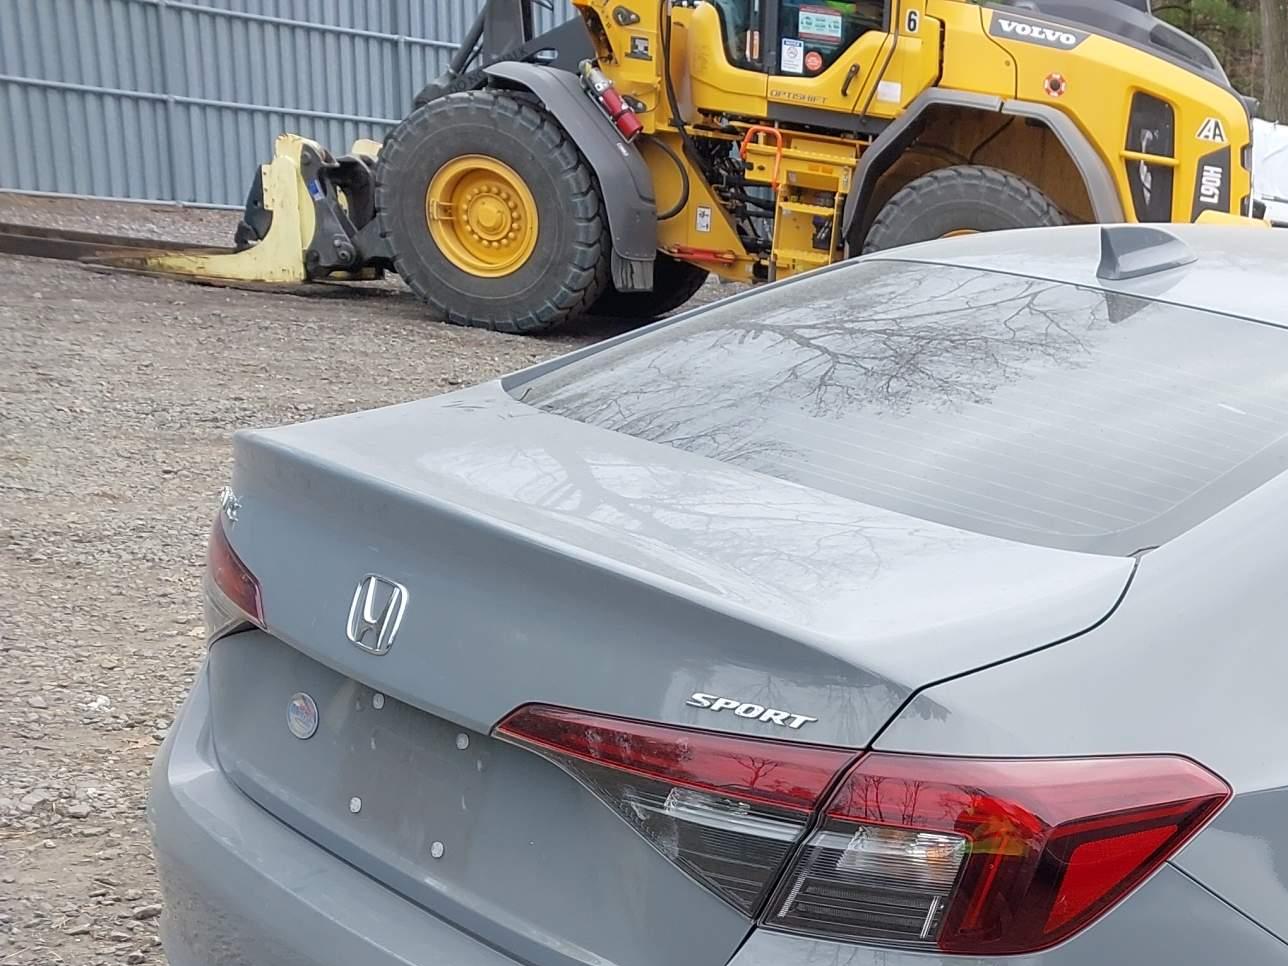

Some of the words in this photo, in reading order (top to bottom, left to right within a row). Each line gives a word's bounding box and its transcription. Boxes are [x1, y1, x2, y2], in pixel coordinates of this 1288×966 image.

[907, 10, 918, 32] 6
[998, 18, 1076, 45] VOLVO
[1200, 165, 1222, 204] L90H
[685, 692, 818, 729] SPORT
